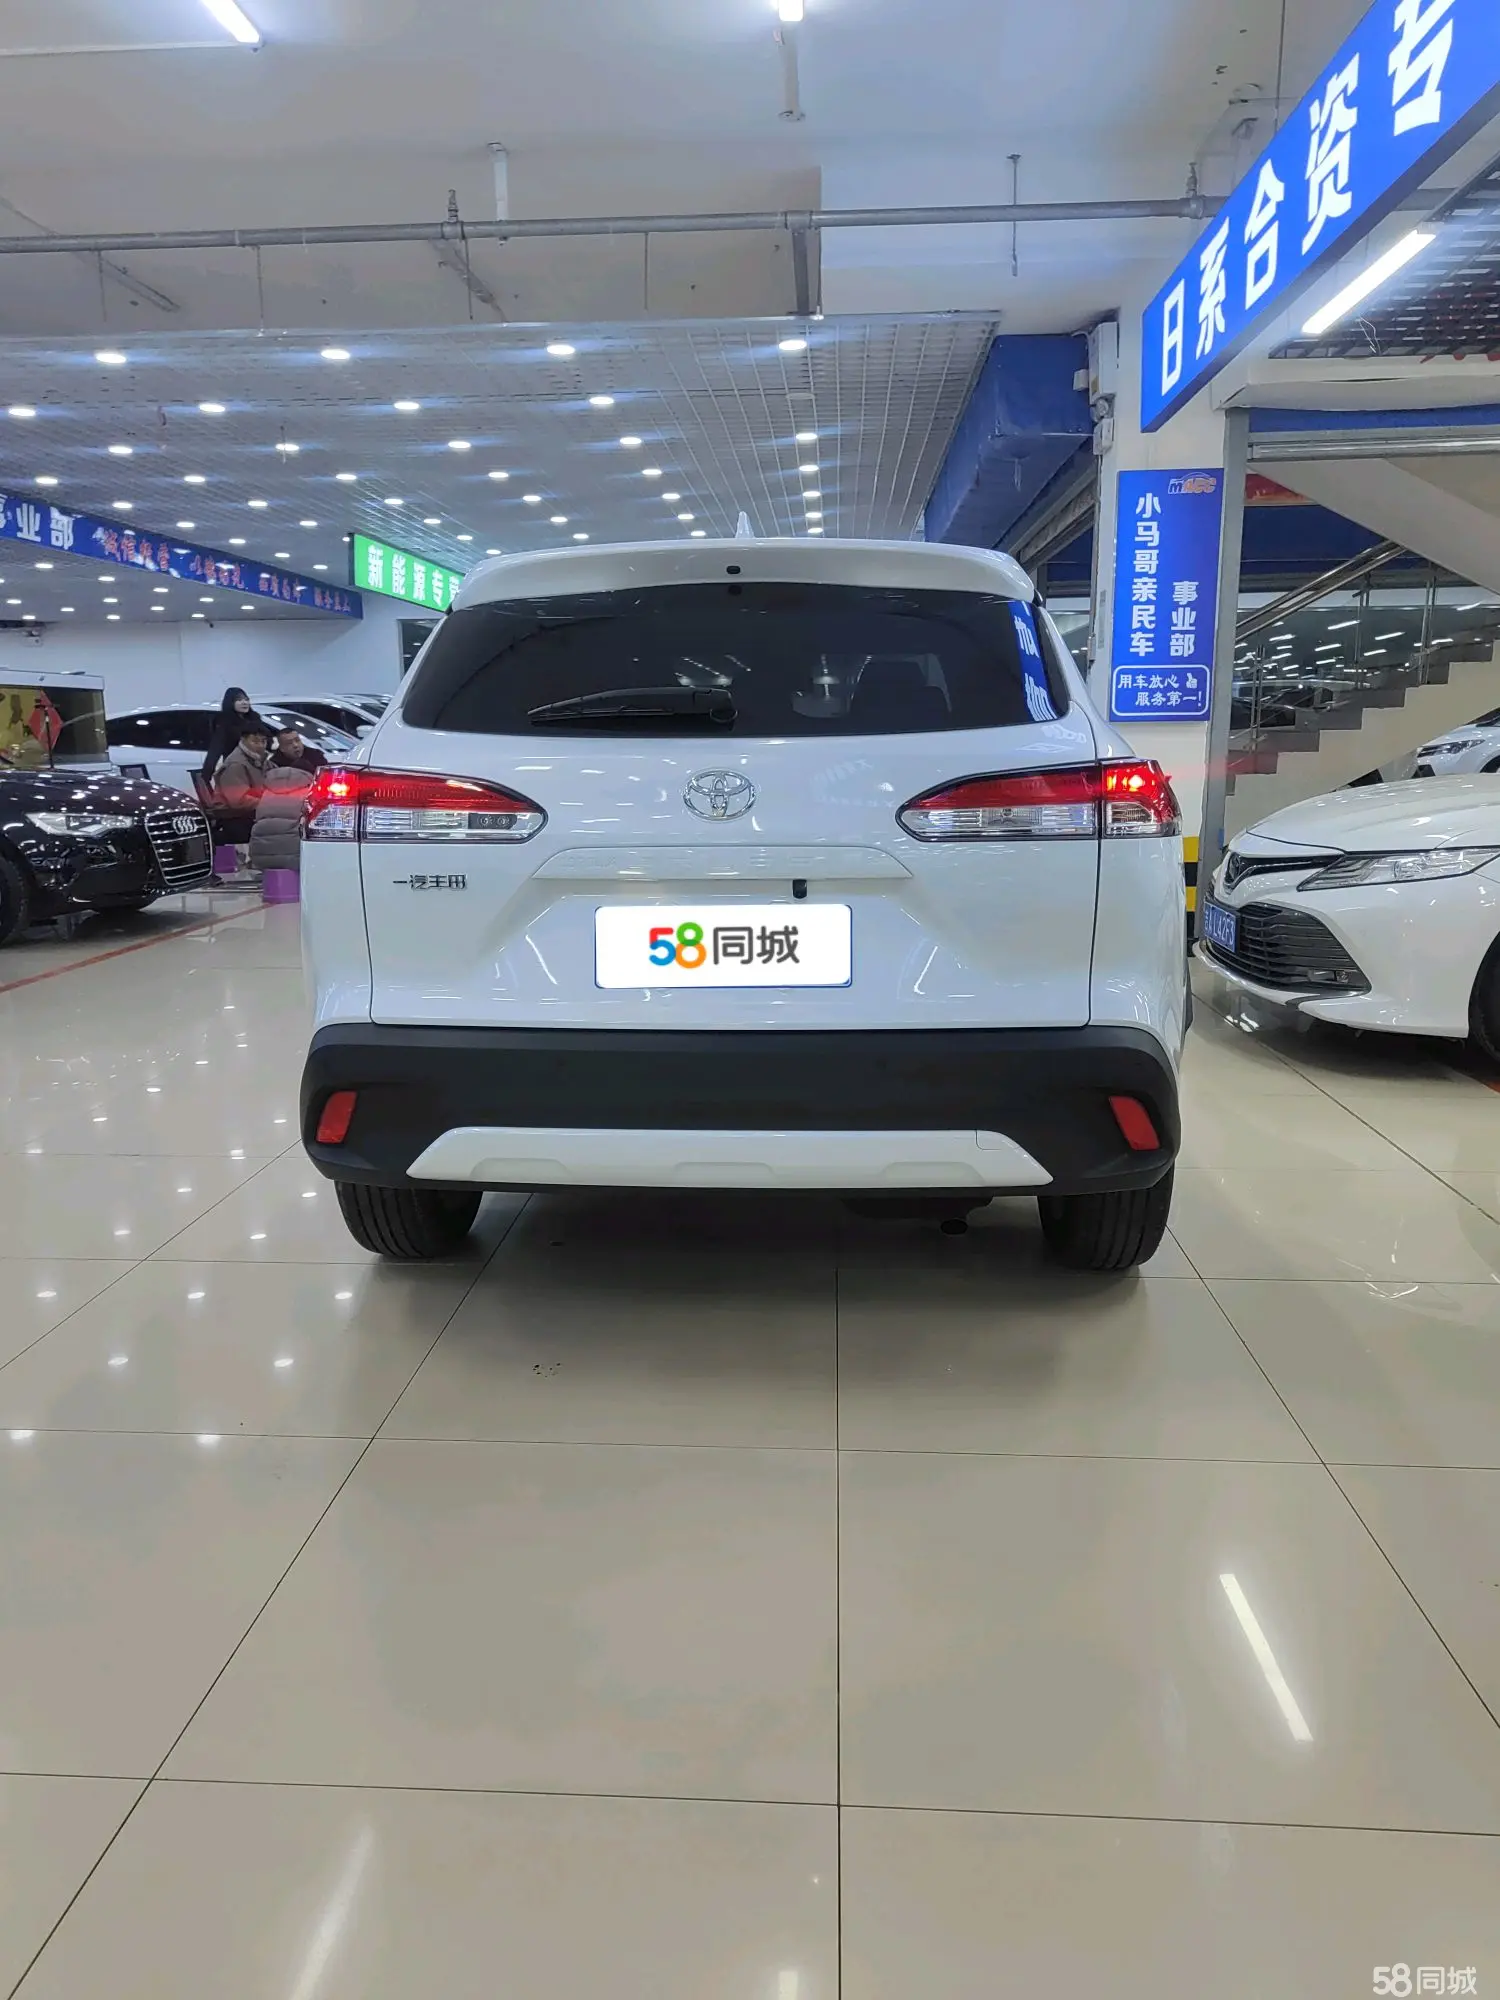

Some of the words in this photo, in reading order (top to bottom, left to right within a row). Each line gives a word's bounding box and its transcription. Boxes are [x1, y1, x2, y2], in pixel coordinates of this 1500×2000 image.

[1161, 0, 1456, 397] 日系合资专
[0, 493, 74, 550] 业部
[1129, 492, 1162, 657] 小马哥亲民车
[1169, 580, 1199, 658] 事业部
[1117, 673, 1180, 690] 用车放心
[392, 874, 467, 890] 一汽丰田
